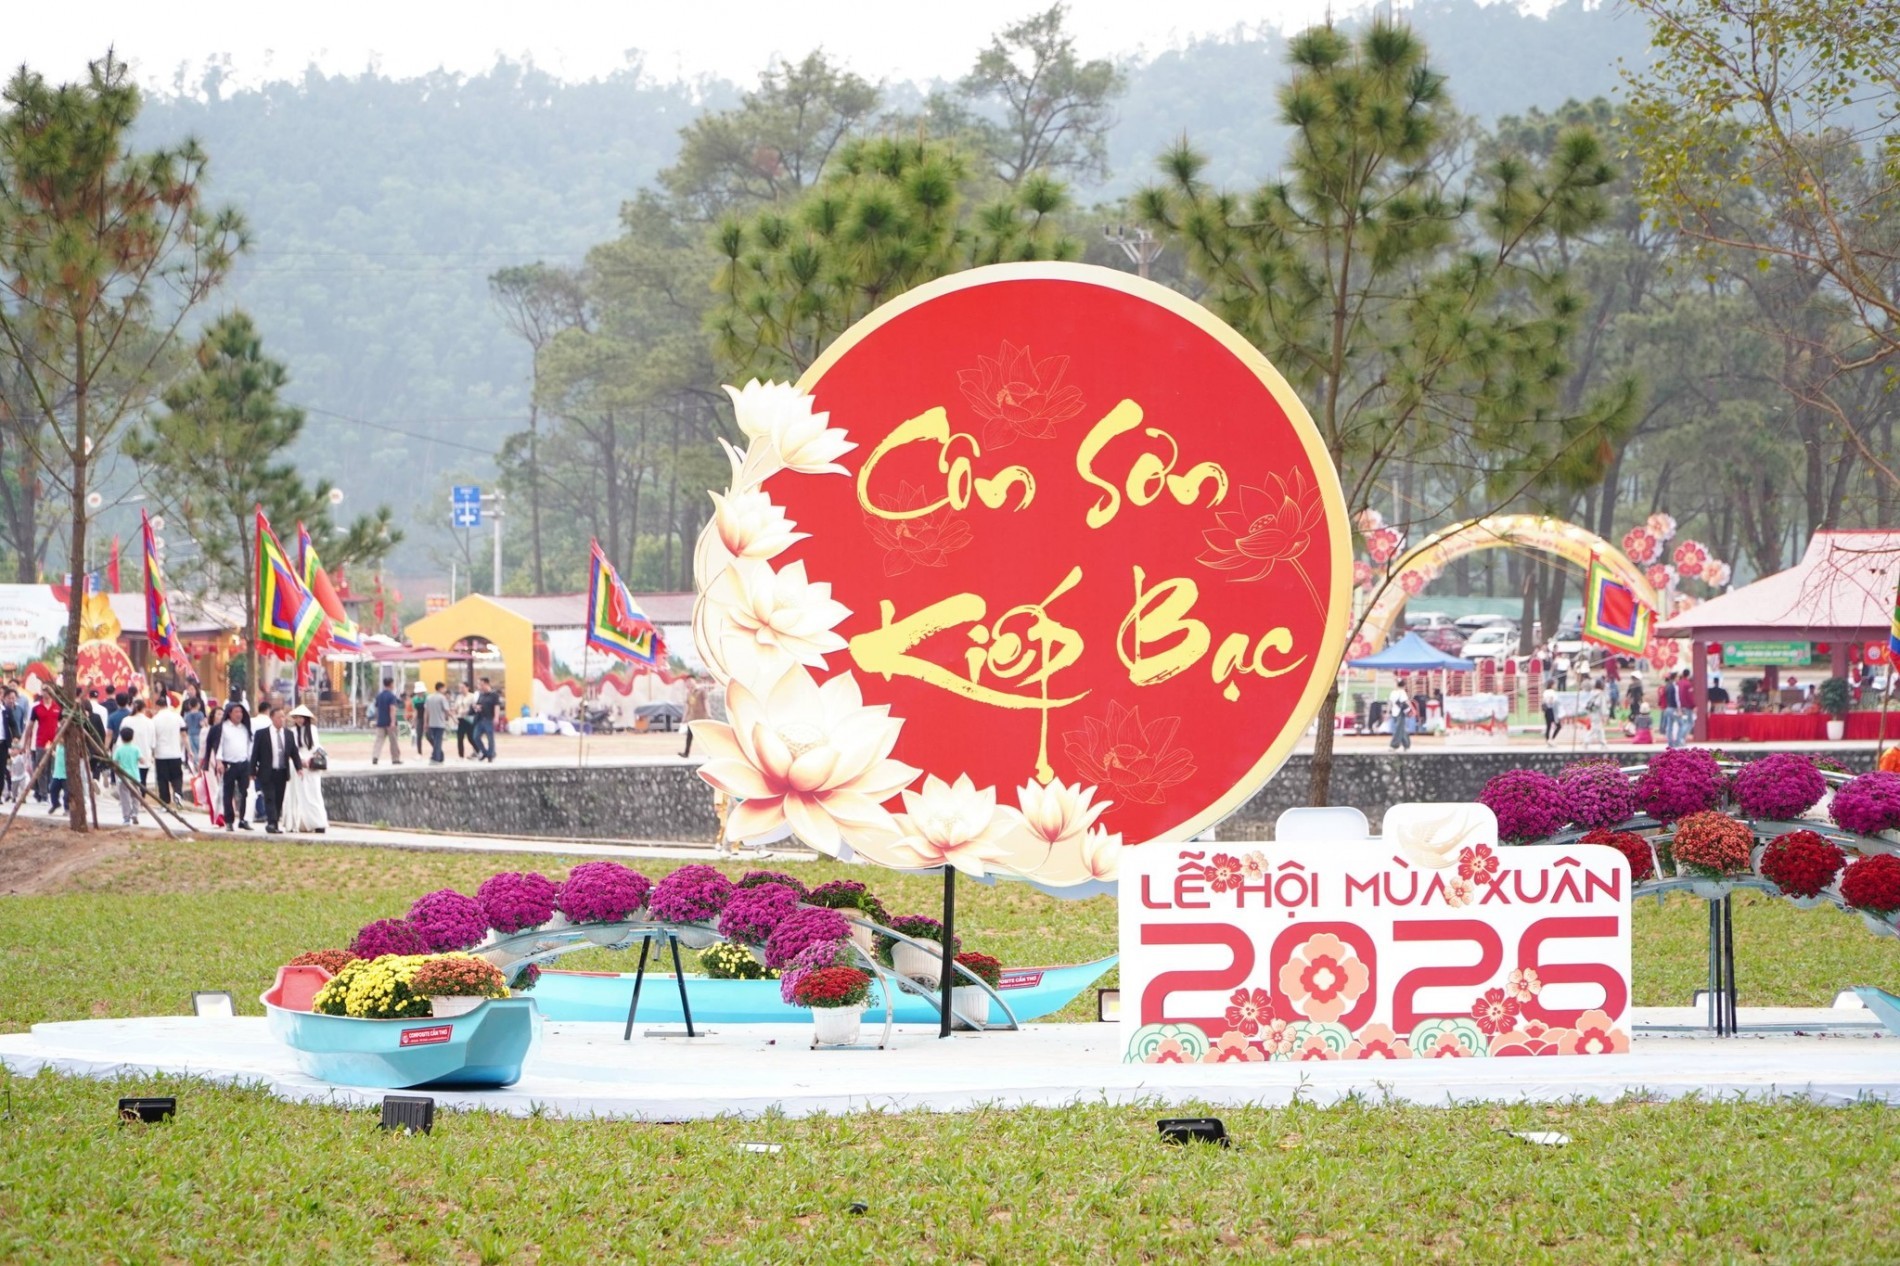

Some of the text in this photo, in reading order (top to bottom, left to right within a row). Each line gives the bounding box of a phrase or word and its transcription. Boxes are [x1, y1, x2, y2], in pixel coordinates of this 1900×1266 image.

[857, 399, 1229, 529] Côn Sơn
[848, 565, 1307, 785] Kiếp Bạc
[1140, 851, 1620, 918] LỄ HỘI MÙA XUÂN
[1140, 915, 1628, 1040] 2026
